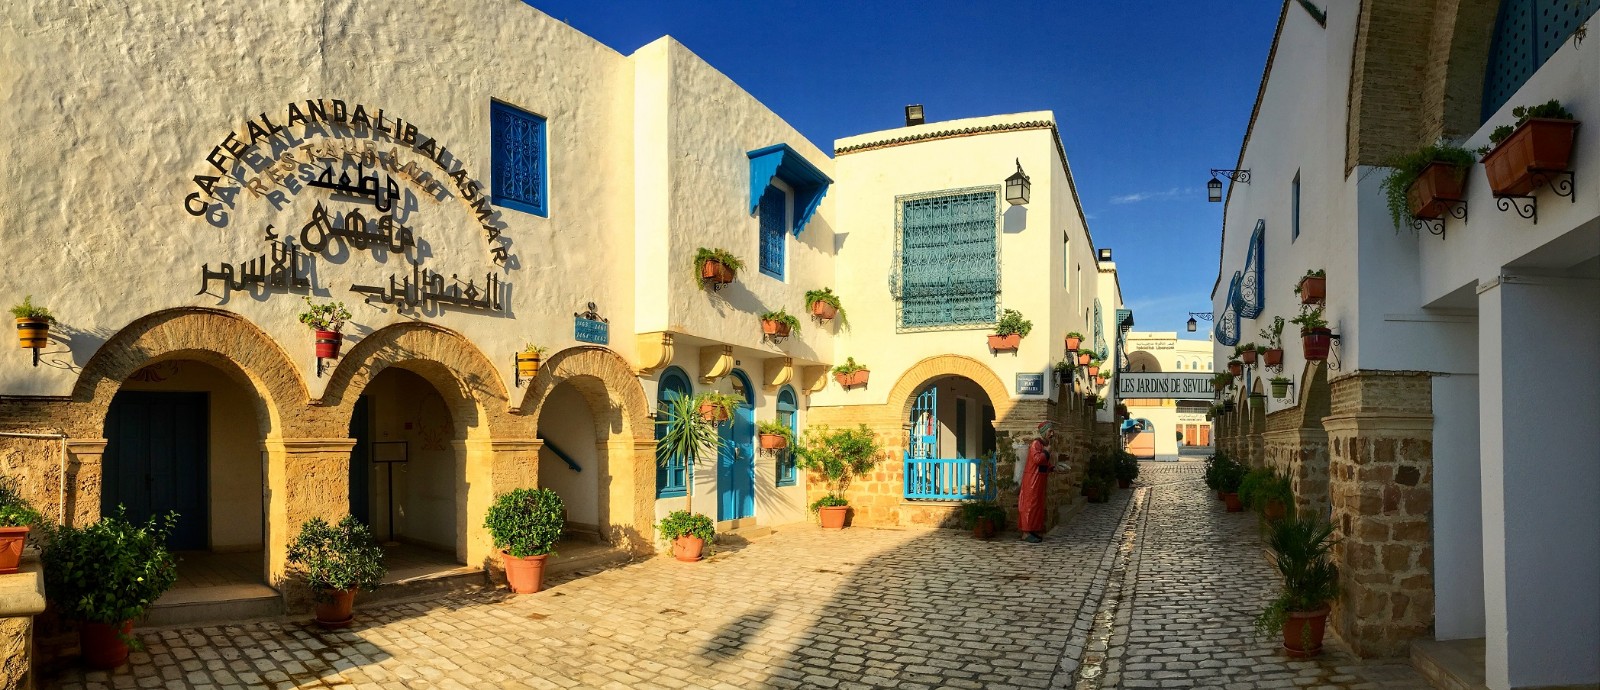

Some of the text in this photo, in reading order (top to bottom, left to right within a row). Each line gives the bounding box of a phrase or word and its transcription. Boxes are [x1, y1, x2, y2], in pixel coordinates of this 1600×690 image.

[246, 137, 456, 202] RESTAURANT
[307, 162, 401, 212] مطعم
[1120, 378, 1215, 394] LES JARDINS DE SEVILLE
